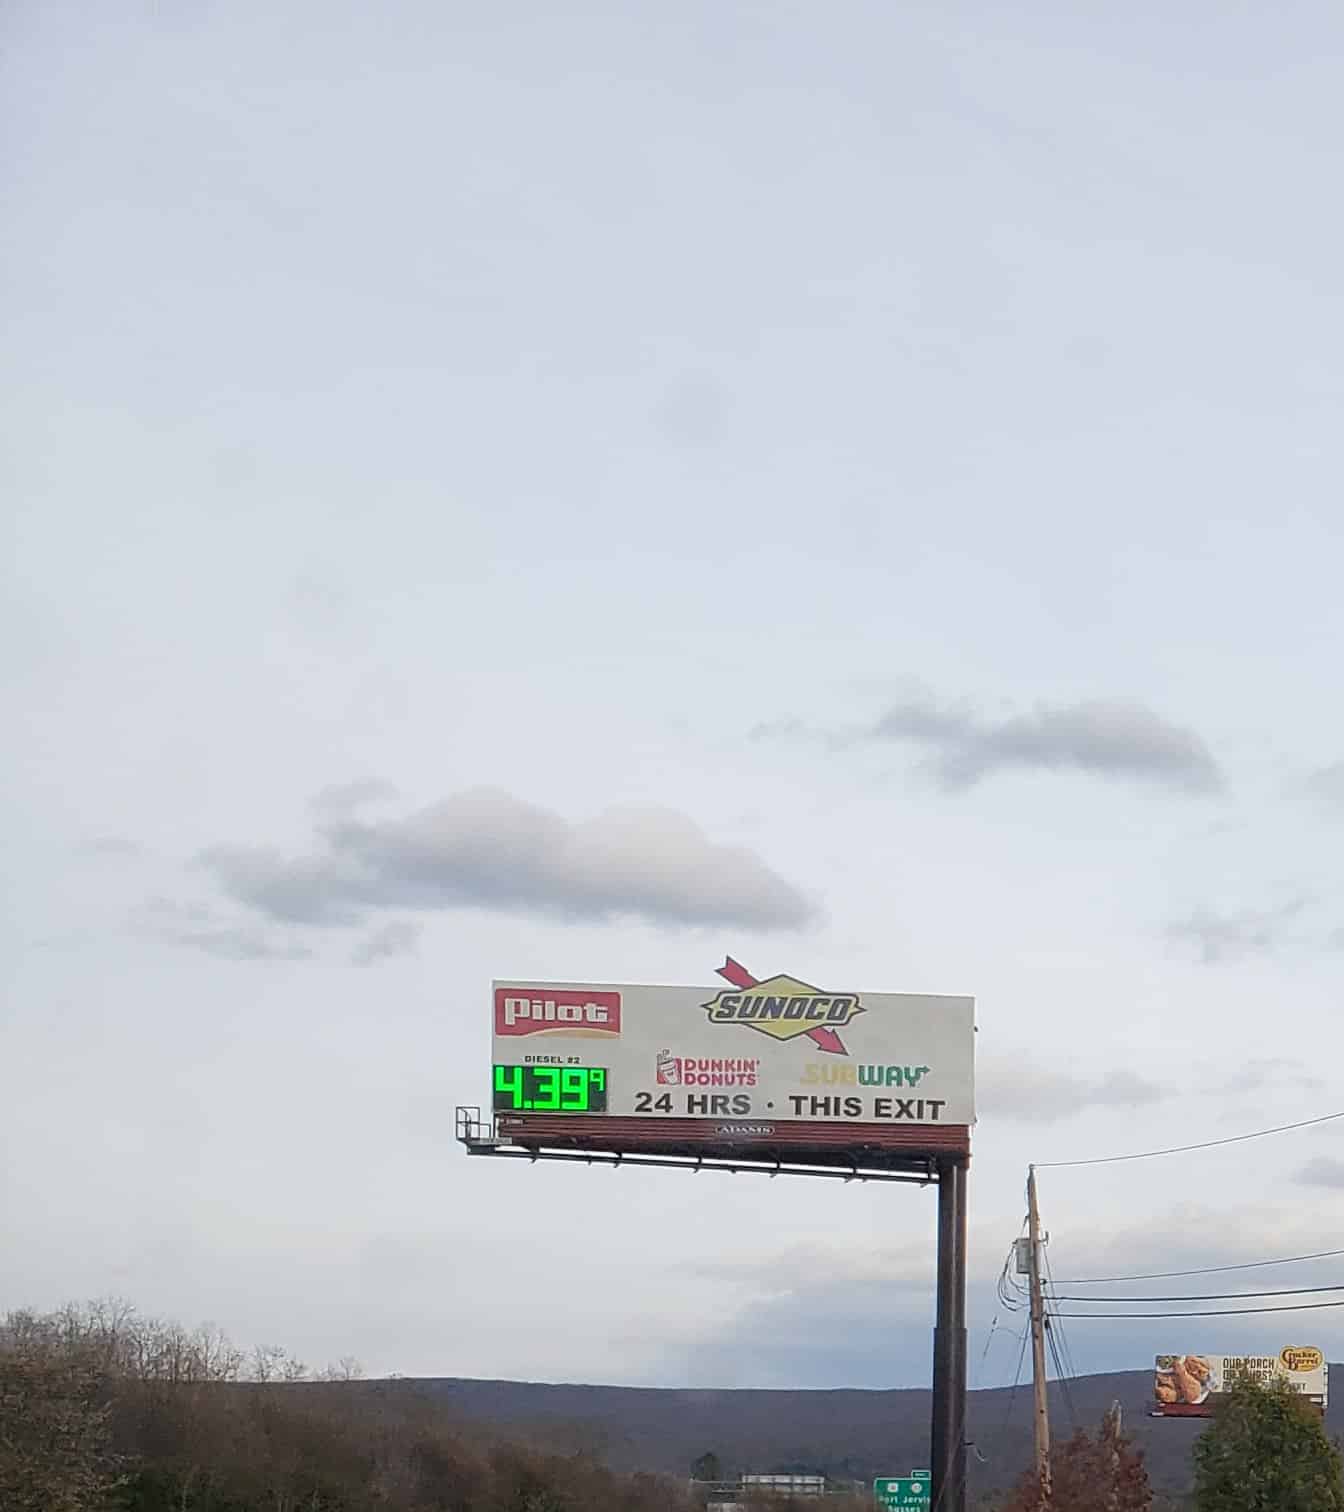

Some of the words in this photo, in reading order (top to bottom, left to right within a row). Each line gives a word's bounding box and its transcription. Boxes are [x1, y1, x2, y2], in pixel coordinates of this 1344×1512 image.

[504, 998, 609, 1025] Pilot
[715, 996, 850, 1021] SUNOCO
[524, 1055, 563, 1064] DIESEL
[567, 1056, 580, 1064] #2
[684, 1059, 760, 1073] DUNKIN'
[684, 1073, 757, 1087] DONUTS
[801, 1063, 931, 1087] SUBWAY
[634, 1091, 674, 1113] 24
[687, 1094, 751, 1115] HRS
[789, 1095, 862, 1117] THIS
[874, 1098, 946, 1121] EXIT
